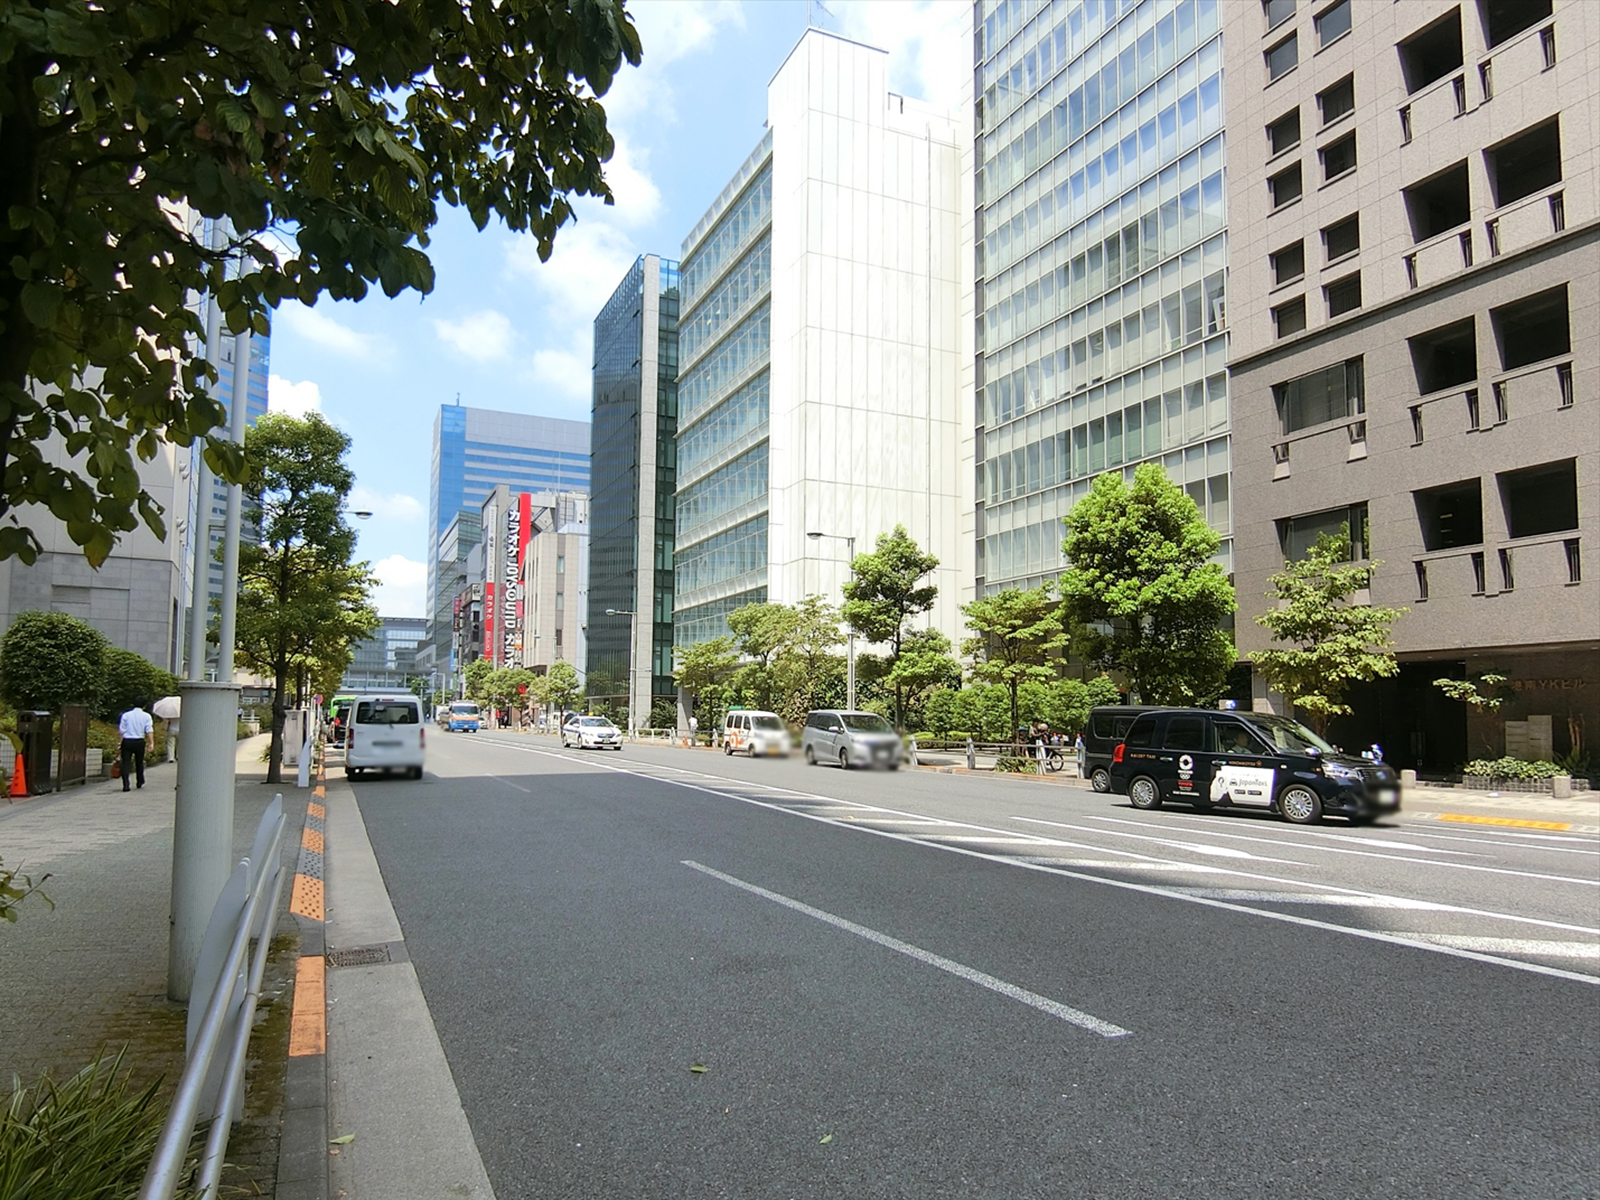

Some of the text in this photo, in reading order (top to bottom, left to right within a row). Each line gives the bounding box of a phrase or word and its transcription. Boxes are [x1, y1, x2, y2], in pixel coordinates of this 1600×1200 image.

[508, 509, 520, 557] カラオケ
[505, 562, 519, 628] JOYSOUND
[1512, 679, 1586, 691] 港南YKビル
